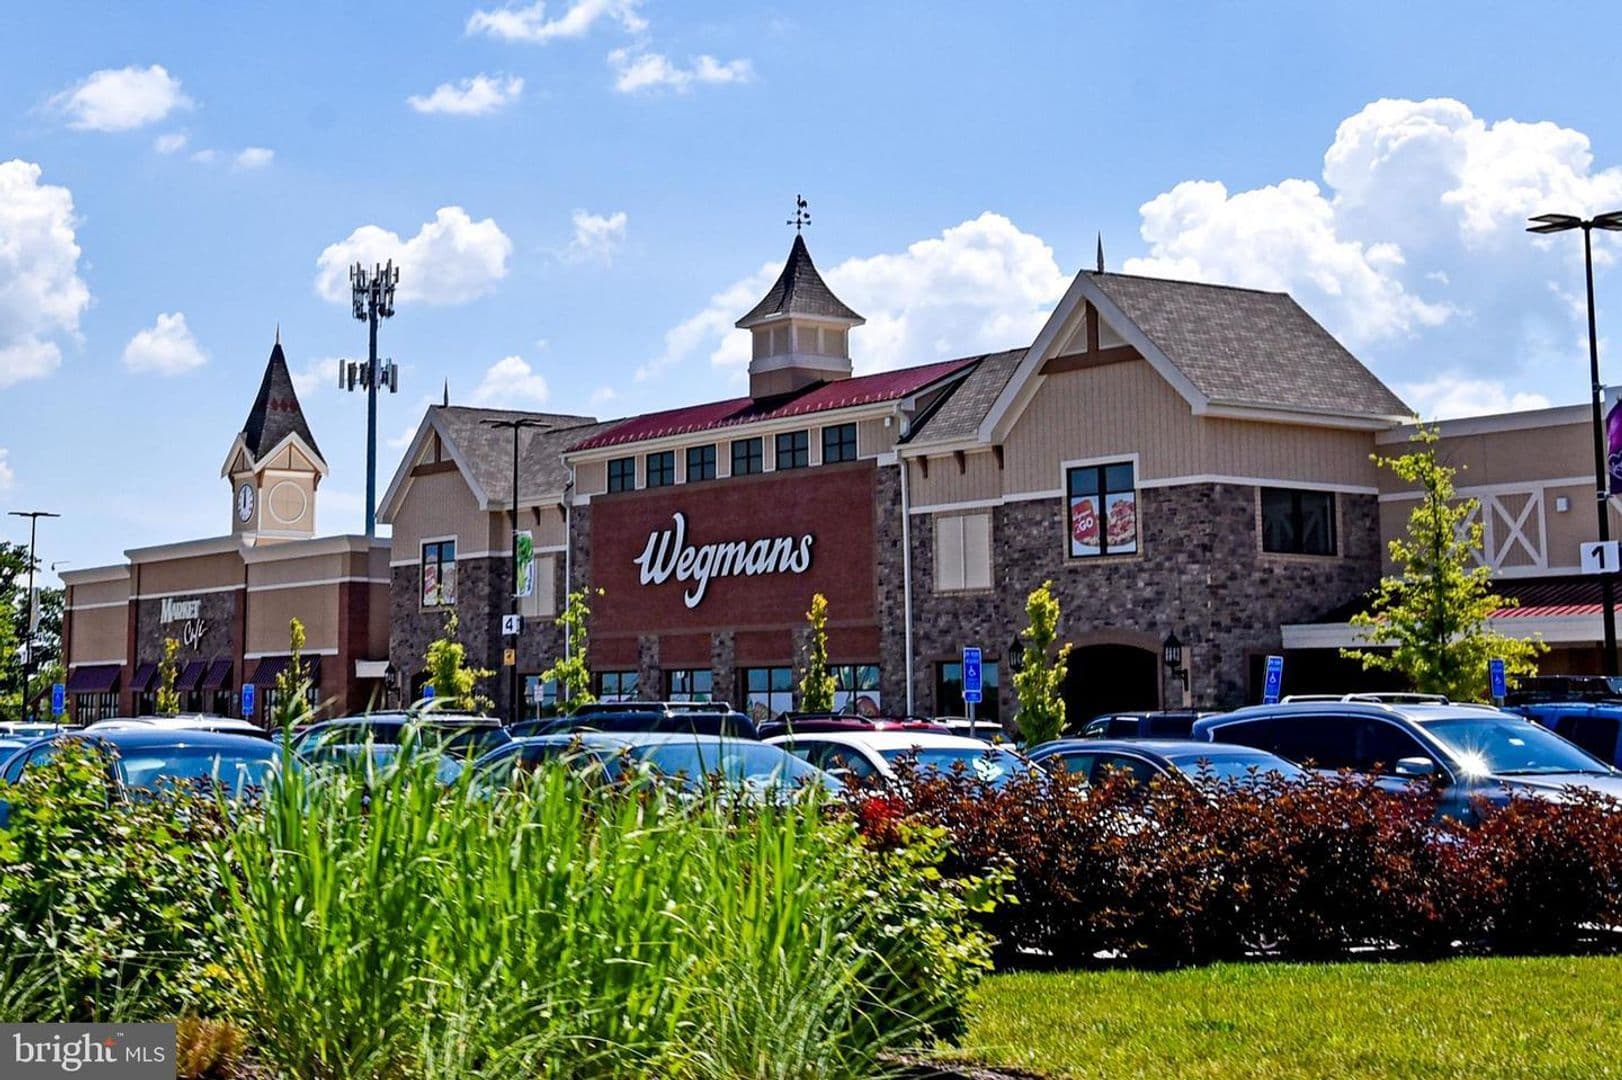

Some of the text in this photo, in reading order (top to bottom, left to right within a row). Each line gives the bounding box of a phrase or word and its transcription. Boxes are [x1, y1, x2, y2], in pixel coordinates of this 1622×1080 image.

[633, 512, 813, 608] Wegmans
[1591, 545, 1605, 569] 1
[505, 617, 513, 631] 4
